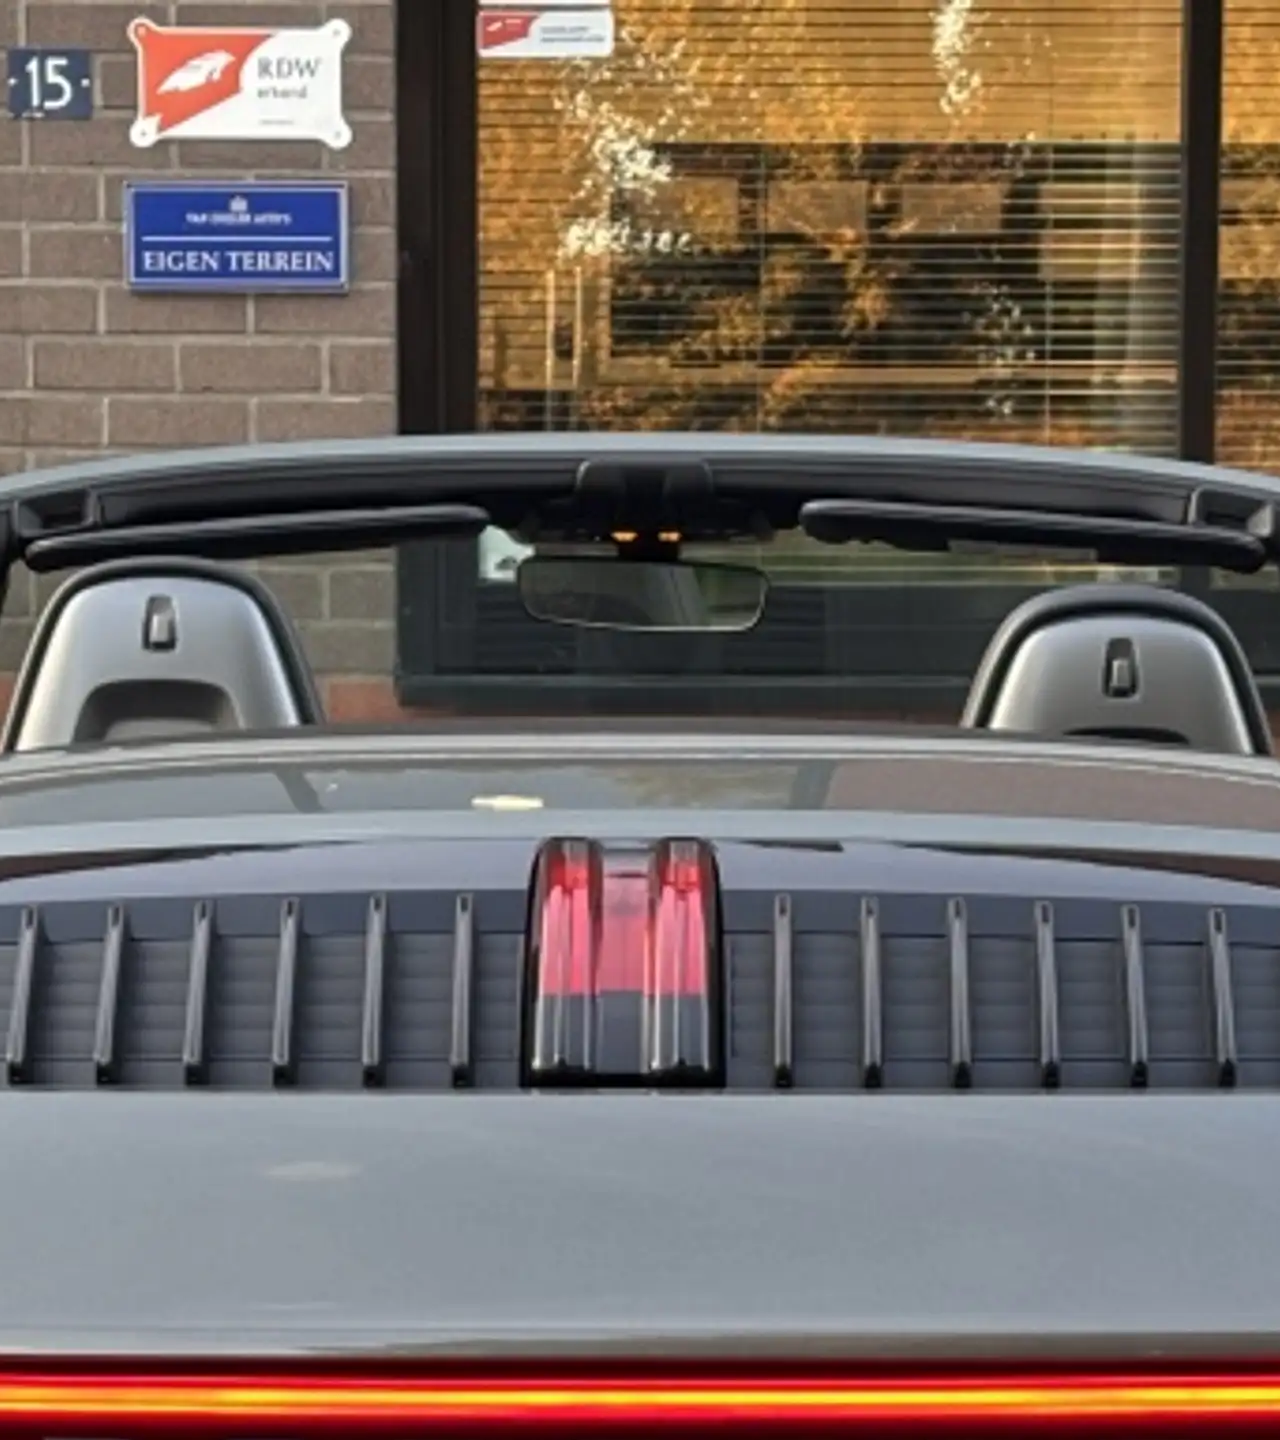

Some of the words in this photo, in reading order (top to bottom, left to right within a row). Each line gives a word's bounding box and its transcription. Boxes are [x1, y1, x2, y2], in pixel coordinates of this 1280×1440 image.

[257, 56, 322, 80] RDW
[25, 56, 72, 110] 15
[142, 250, 219, 272] EIGEN
[225, 250, 334, 272] TERREIN
